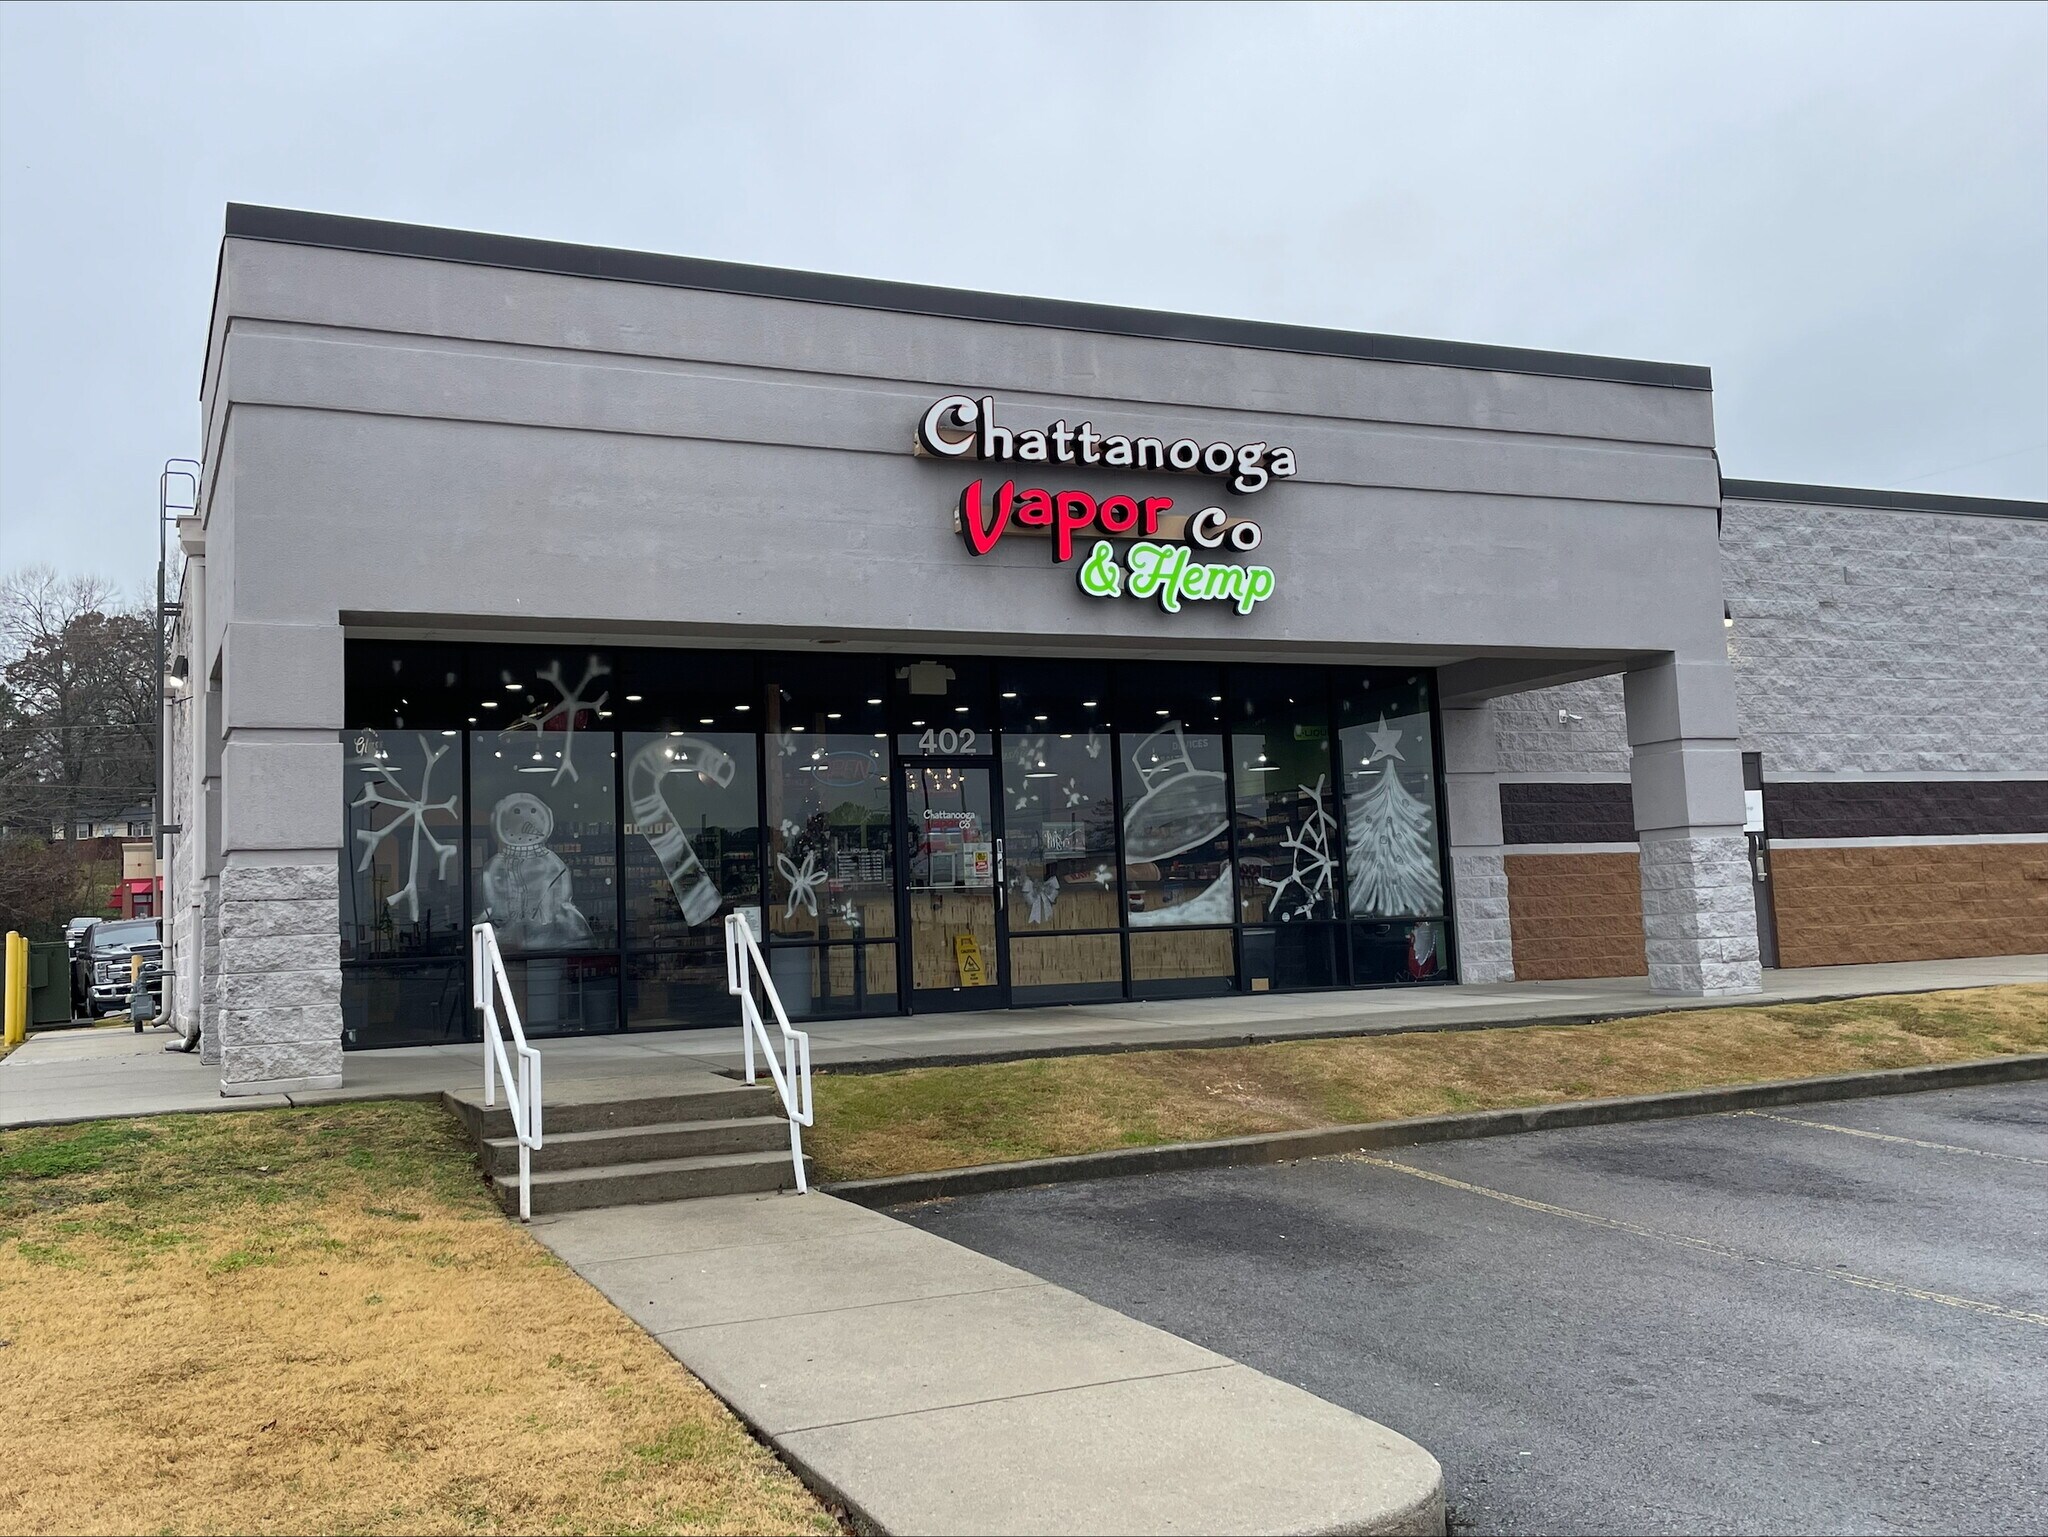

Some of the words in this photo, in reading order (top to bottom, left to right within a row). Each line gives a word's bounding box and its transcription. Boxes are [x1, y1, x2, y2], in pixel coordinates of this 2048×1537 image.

[921, 394, 1298, 494] Chattanooga
[961, 478, 1174, 562] Vapor
[1191, 506, 1263, 551] Co
[1079, 540, 1121, 598] &
[1127, 541, 1276, 616] Hemp
[918, 727, 977, 754] 402
[1172, 738, 1209, 751] DICES
[923, 808, 976, 823] Chattanooga
[958, 820, 971, 829] Co
